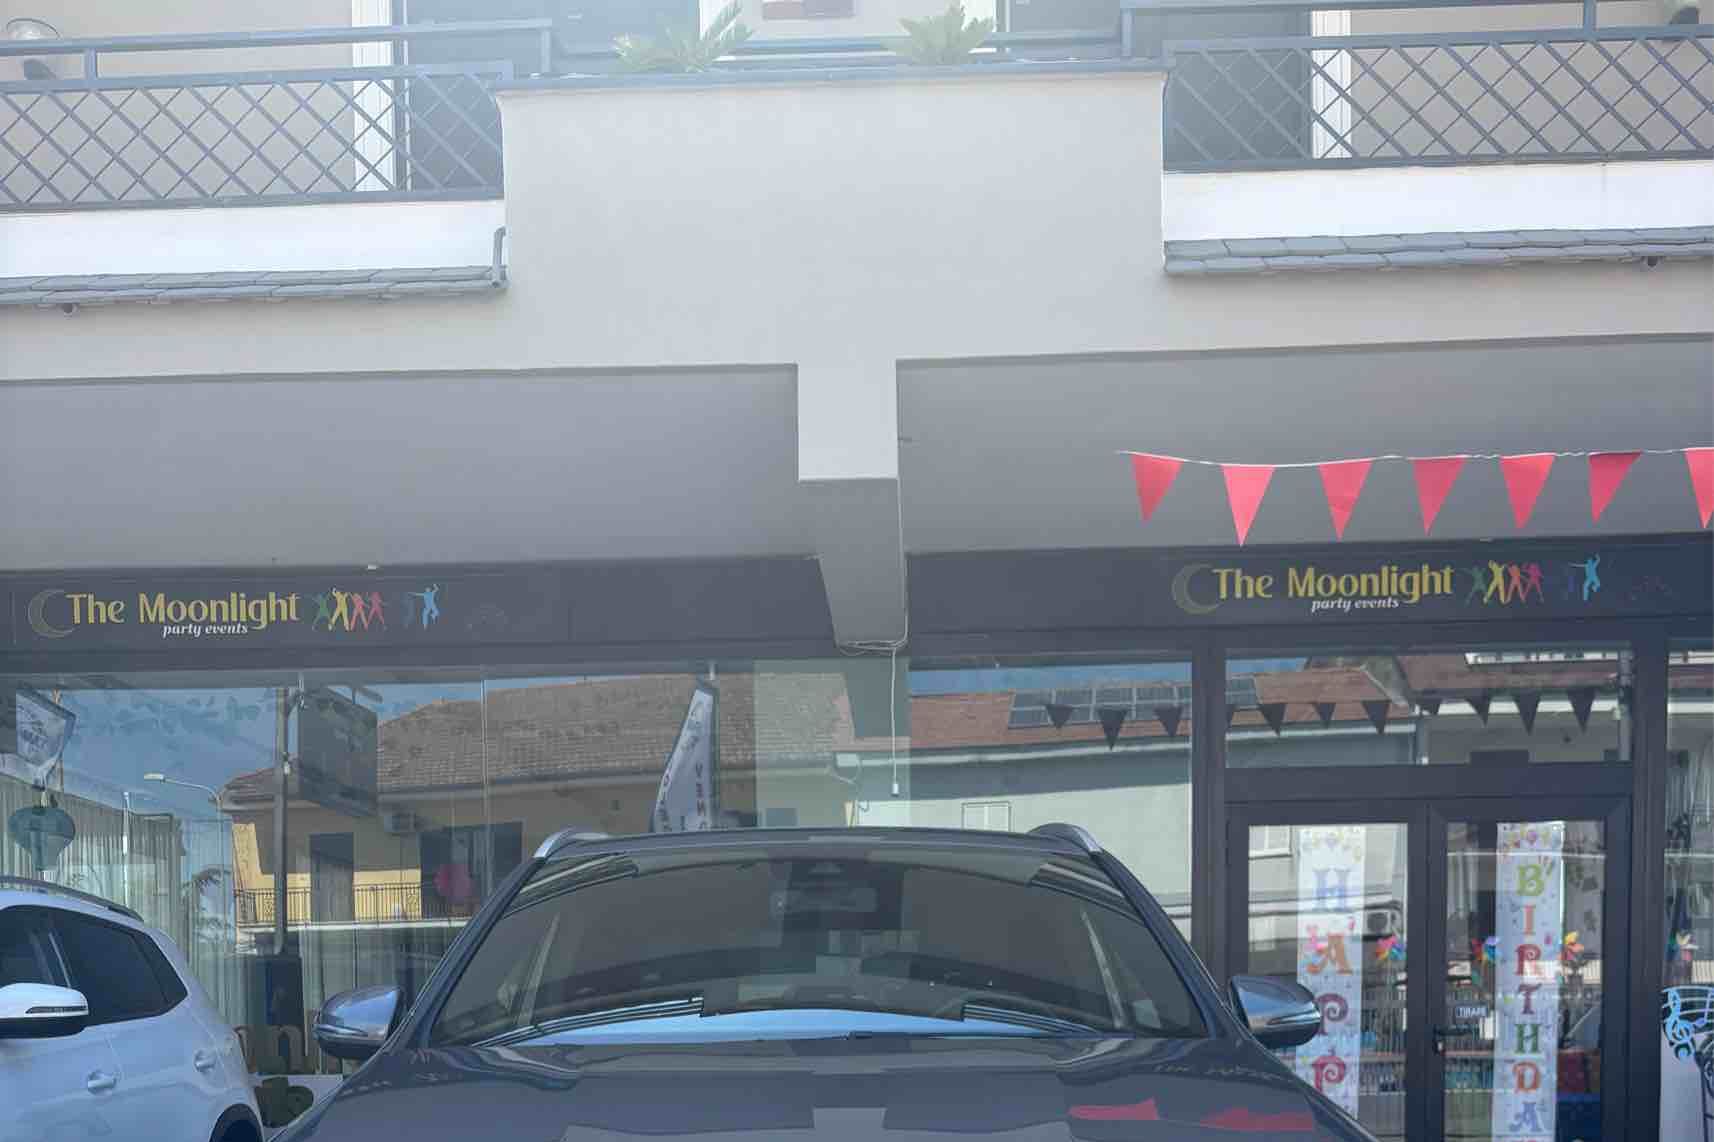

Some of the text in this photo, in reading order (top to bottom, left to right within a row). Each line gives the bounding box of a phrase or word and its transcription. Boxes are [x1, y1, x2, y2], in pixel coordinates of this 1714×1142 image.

[1212, 562, 1455, 604] The Moonlight
[65, 591, 300, 629] The Moonlight
[1310, 596, 1400, 613] party events
[162, 622, 249, 640] party events
[1306, 867, 1353, 1094] HAPP
